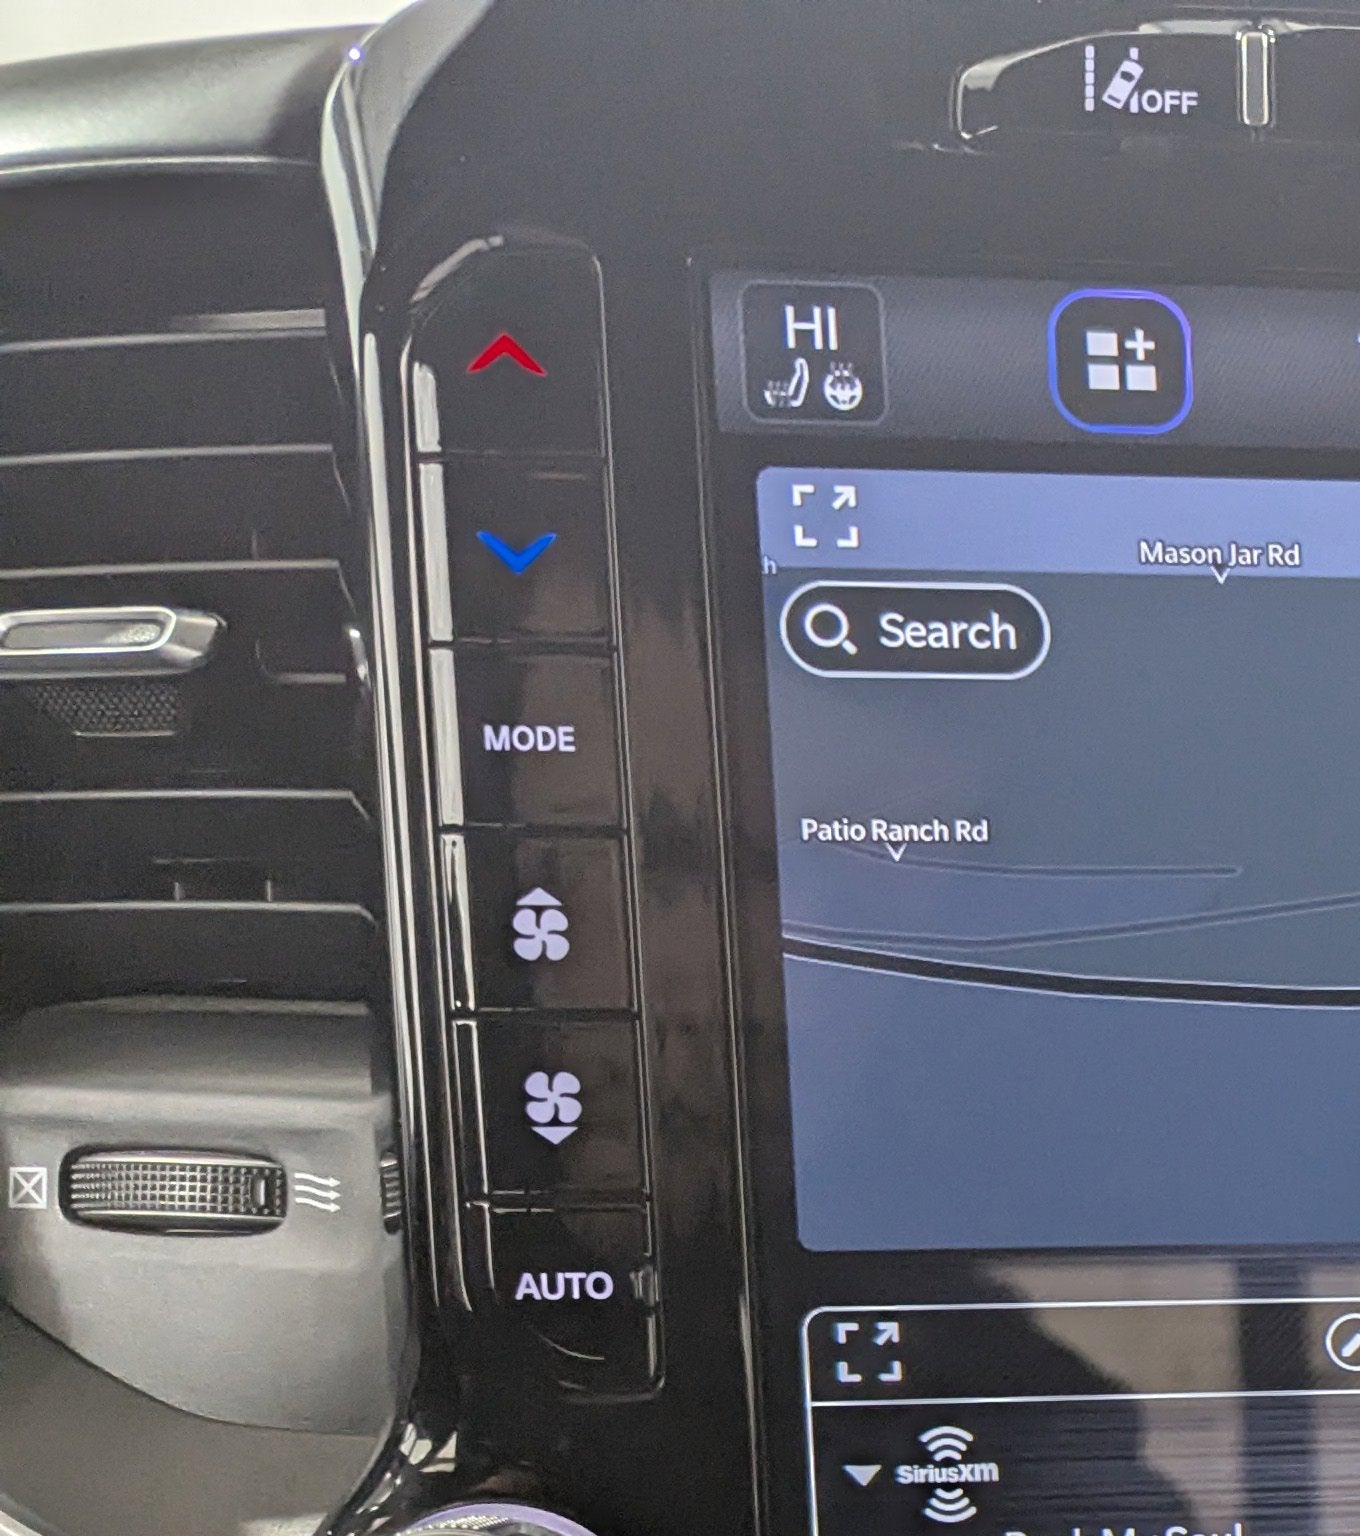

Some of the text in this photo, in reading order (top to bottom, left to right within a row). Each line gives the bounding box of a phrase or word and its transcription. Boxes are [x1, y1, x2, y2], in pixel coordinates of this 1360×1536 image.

[1141, 89, 1199, 115] OFF
[784, 304, 838, 351] HI
[1139, 539, 1300, 569] Mason Jar Rd
[879, 611, 1017, 650] Search
[483, 724, 576, 753] MODE
[801, 817, 988, 842] Patio Ranch Rd
[515, 1271, 614, 1301] AUTO
